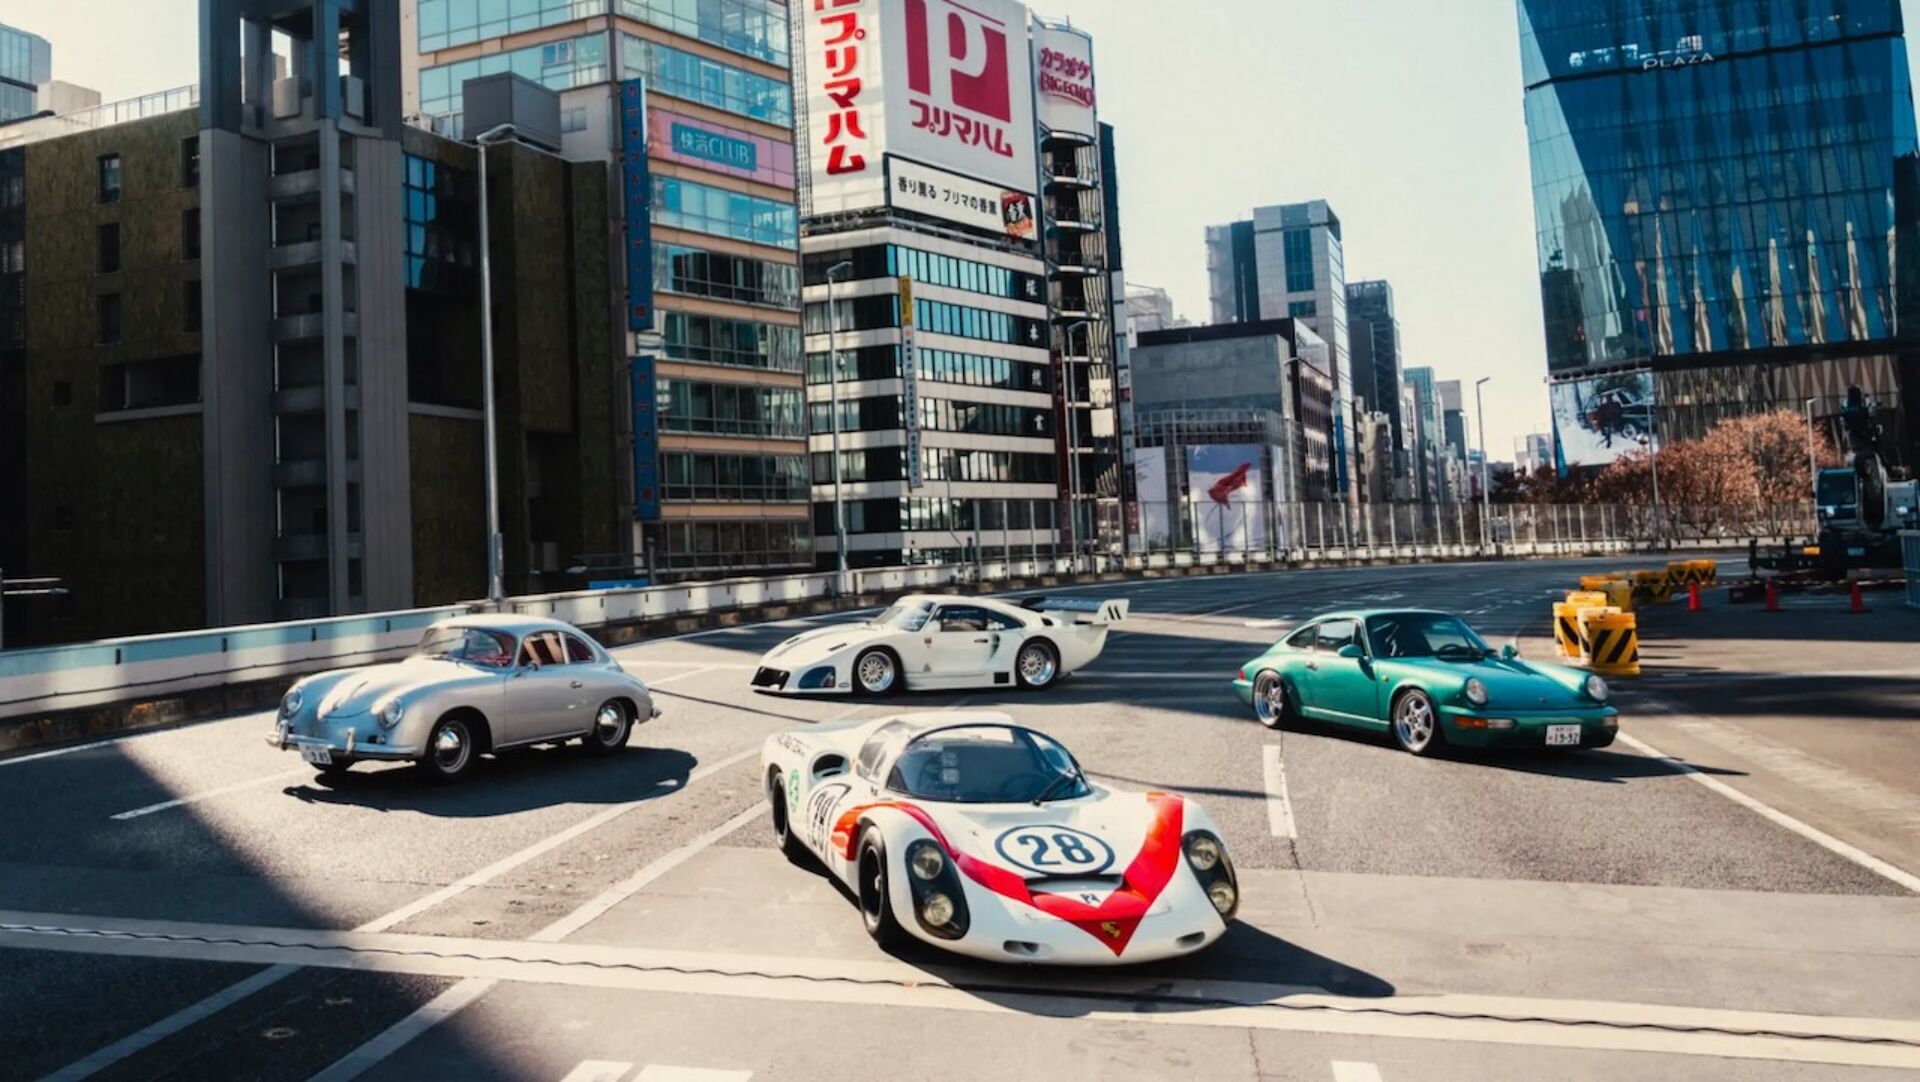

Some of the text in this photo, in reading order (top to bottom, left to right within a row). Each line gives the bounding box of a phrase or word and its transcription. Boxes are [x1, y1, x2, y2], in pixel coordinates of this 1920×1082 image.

[1041, 47, 1090, 80] カラオケ
[1643, 52, 1714, 70] PLAZA
[819, 12, 866, 176] プリマハム
[909, 99, 1013, 157] プリマハム
[1016, 833, 1095, 865] 28
